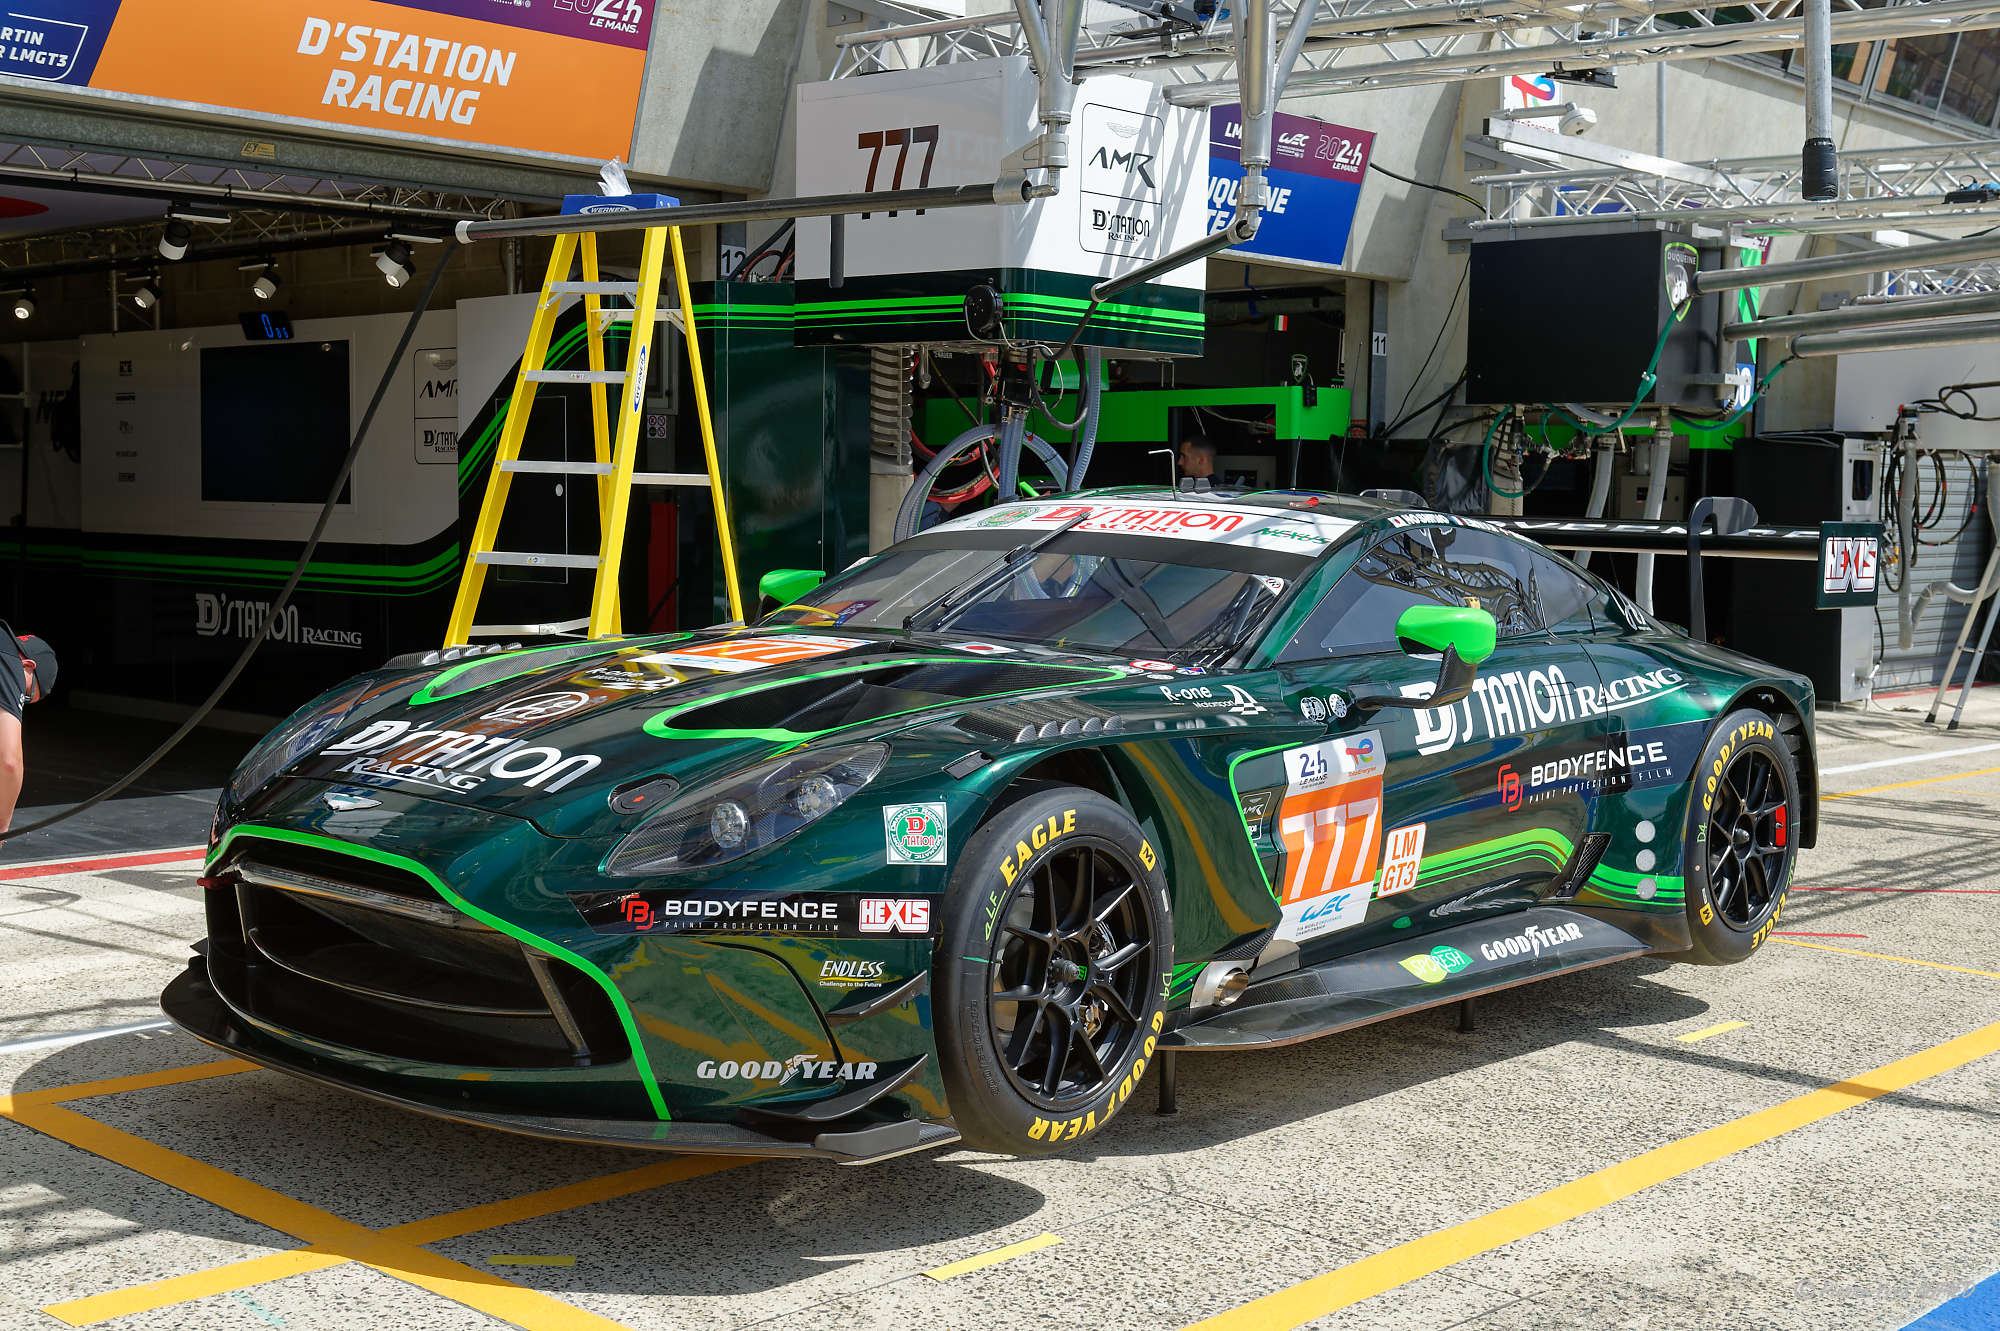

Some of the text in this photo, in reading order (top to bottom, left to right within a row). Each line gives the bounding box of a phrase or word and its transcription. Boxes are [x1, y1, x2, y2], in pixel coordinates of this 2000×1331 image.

[589, 16, 639, 34] LE MANS
[9, 47, 69, 68] LMGT3
[297, 16, 517, 87] D'STATION
[321, 69, 481, 125] RACING
[858, 124, 939, 220] 777
[1088, 146, 1156, 188] AMR
[1092, 209, 1150, 237] D'STATION
[721, 249, 746, 274] 12
[1667, 251, 1697, 265] DUQUEINE
[1374, 335, 1387, 355] 11
[1826, 540, 1876, 590] HEXIS
[196, 592, 363, 649] D'STATION RACING
[1159, 684, 1213, 702] R-one
[1573, 666, 1685, 719] RACING
[319, 720, 602, 794] D'STATION
[336, 756, 487, 791] RACING
[1530, 741, 1668, 787] BODYFENCE
[1529, 768, 1672, 804] PAINT PROTECTION FILM
[1000, 809, 1077, 888] EAGLE
[1282, 797, 1378, 901] 777
[1391, 829, 1418, 861] LM
[1383, 860, 1417, 893] GT3
[664, 900, 838, 919] BODYFENCE
[860, 900, 929, 932] HEXIS
[1299, 893, 1351, 923] WEC
[665, 921, 702, 929] PAINT
[714, 922, 797, 931] PROTECTION
[820, 960, 885, 978] ENDLESS
